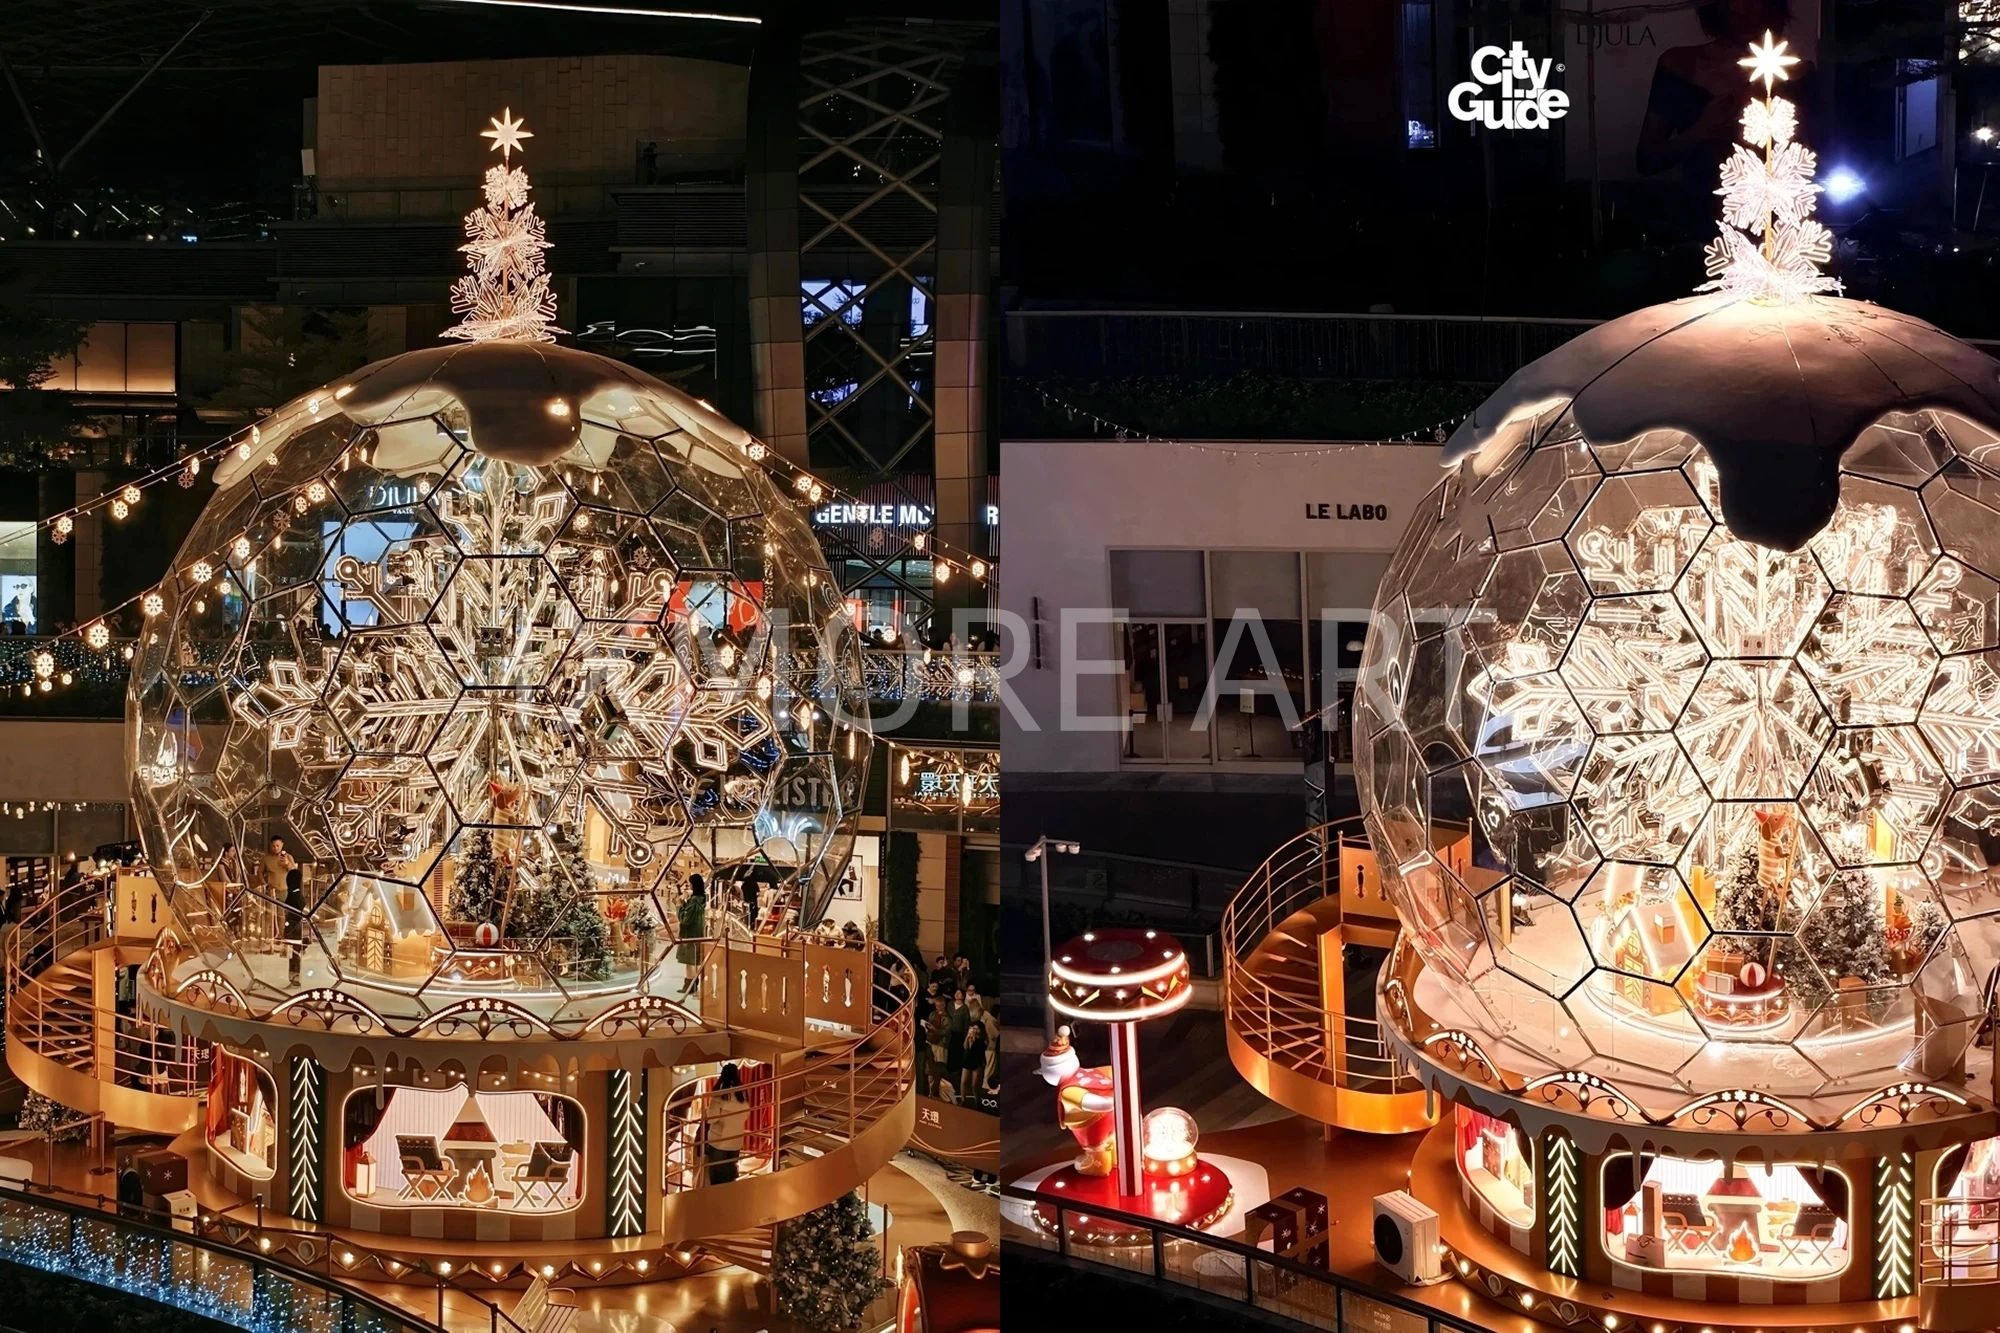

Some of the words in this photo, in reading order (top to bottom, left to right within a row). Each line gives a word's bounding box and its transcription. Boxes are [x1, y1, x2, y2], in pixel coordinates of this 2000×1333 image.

[816, 505, 893, 524] GENTLE
[1306, 503, 1330, 519] LE
[1336, 503, 1387, 521] LABO
